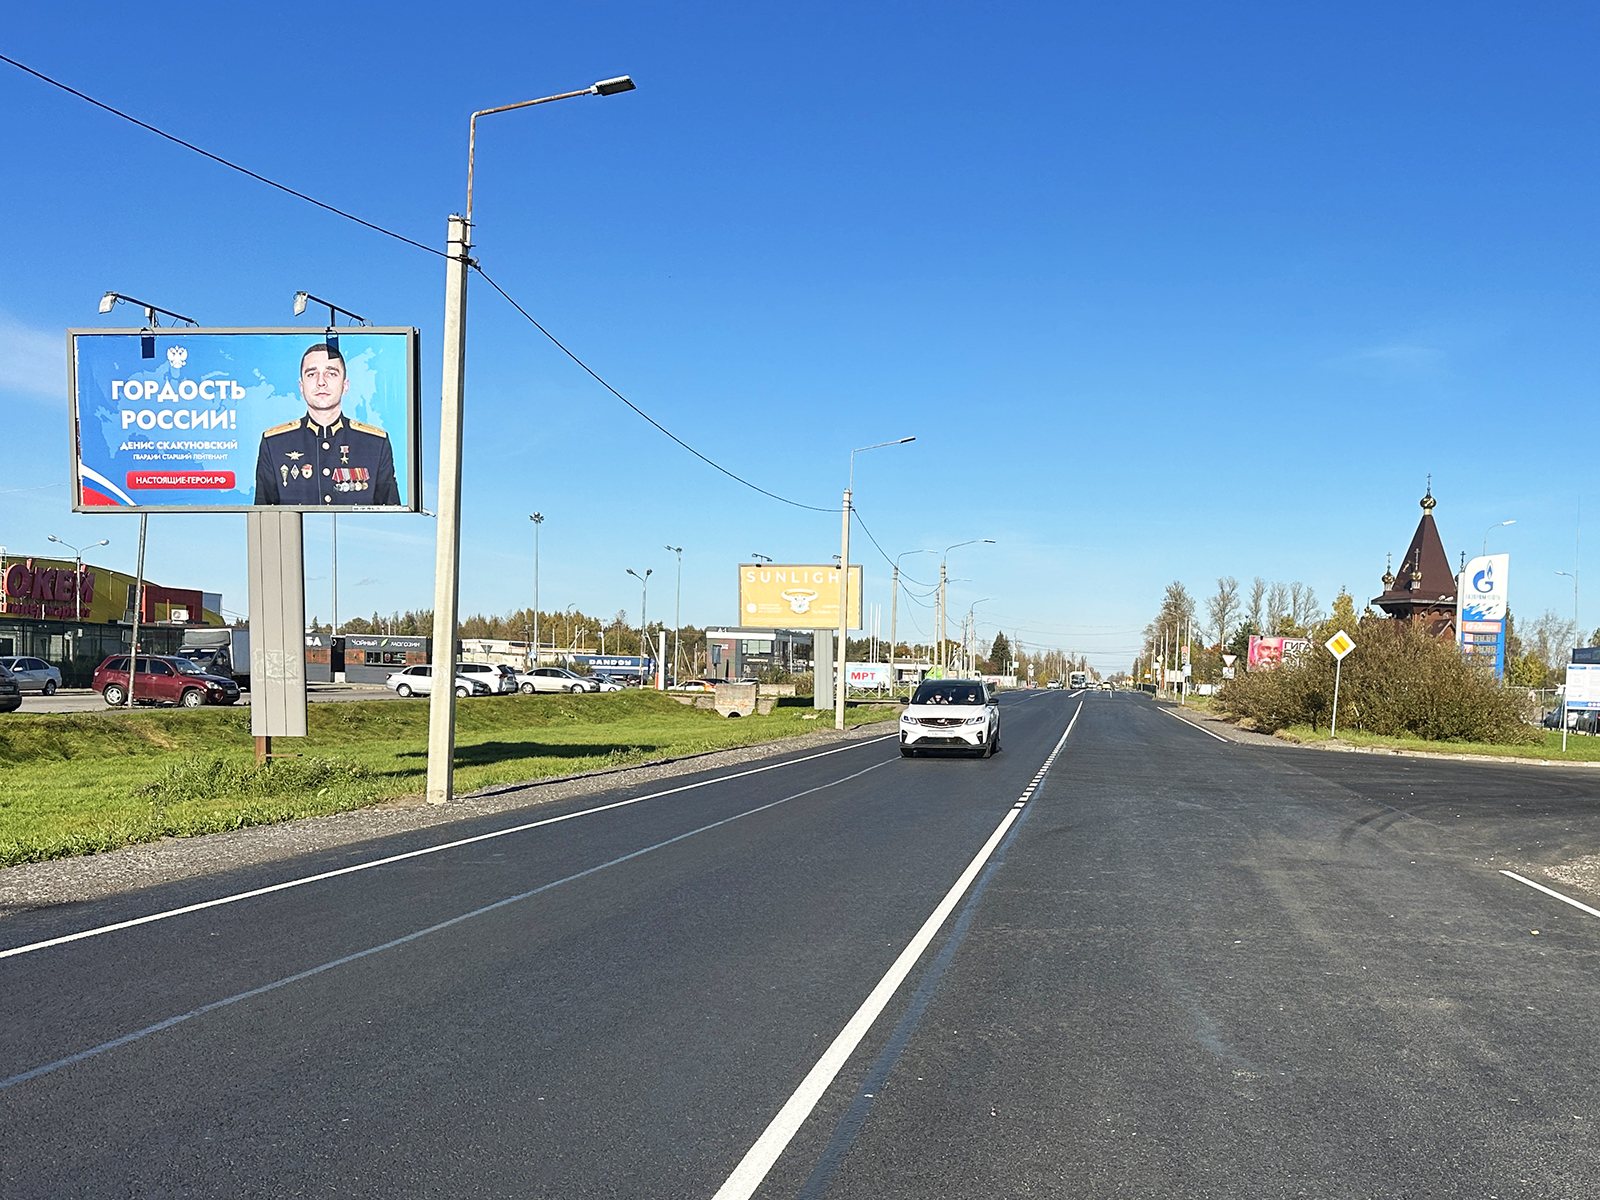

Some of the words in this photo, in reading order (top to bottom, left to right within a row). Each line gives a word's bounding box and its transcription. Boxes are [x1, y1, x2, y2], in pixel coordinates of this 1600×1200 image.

[111, 379, 246, 403] ГОРДОСТЬ
[121, 409, 237, 430] РОССИИ!
[120, 441, 155, 450] ДЕНИС
[157, 439, 238, 450] СКАКУНОВСКИЙ
[133, 453, 161, 461] ГВАРДИИ
[135, 476, 227, 485] НАСТОЯЩИЕ-ГЕРОИ.РФ
[850, 671, 876, 680] МРТ
